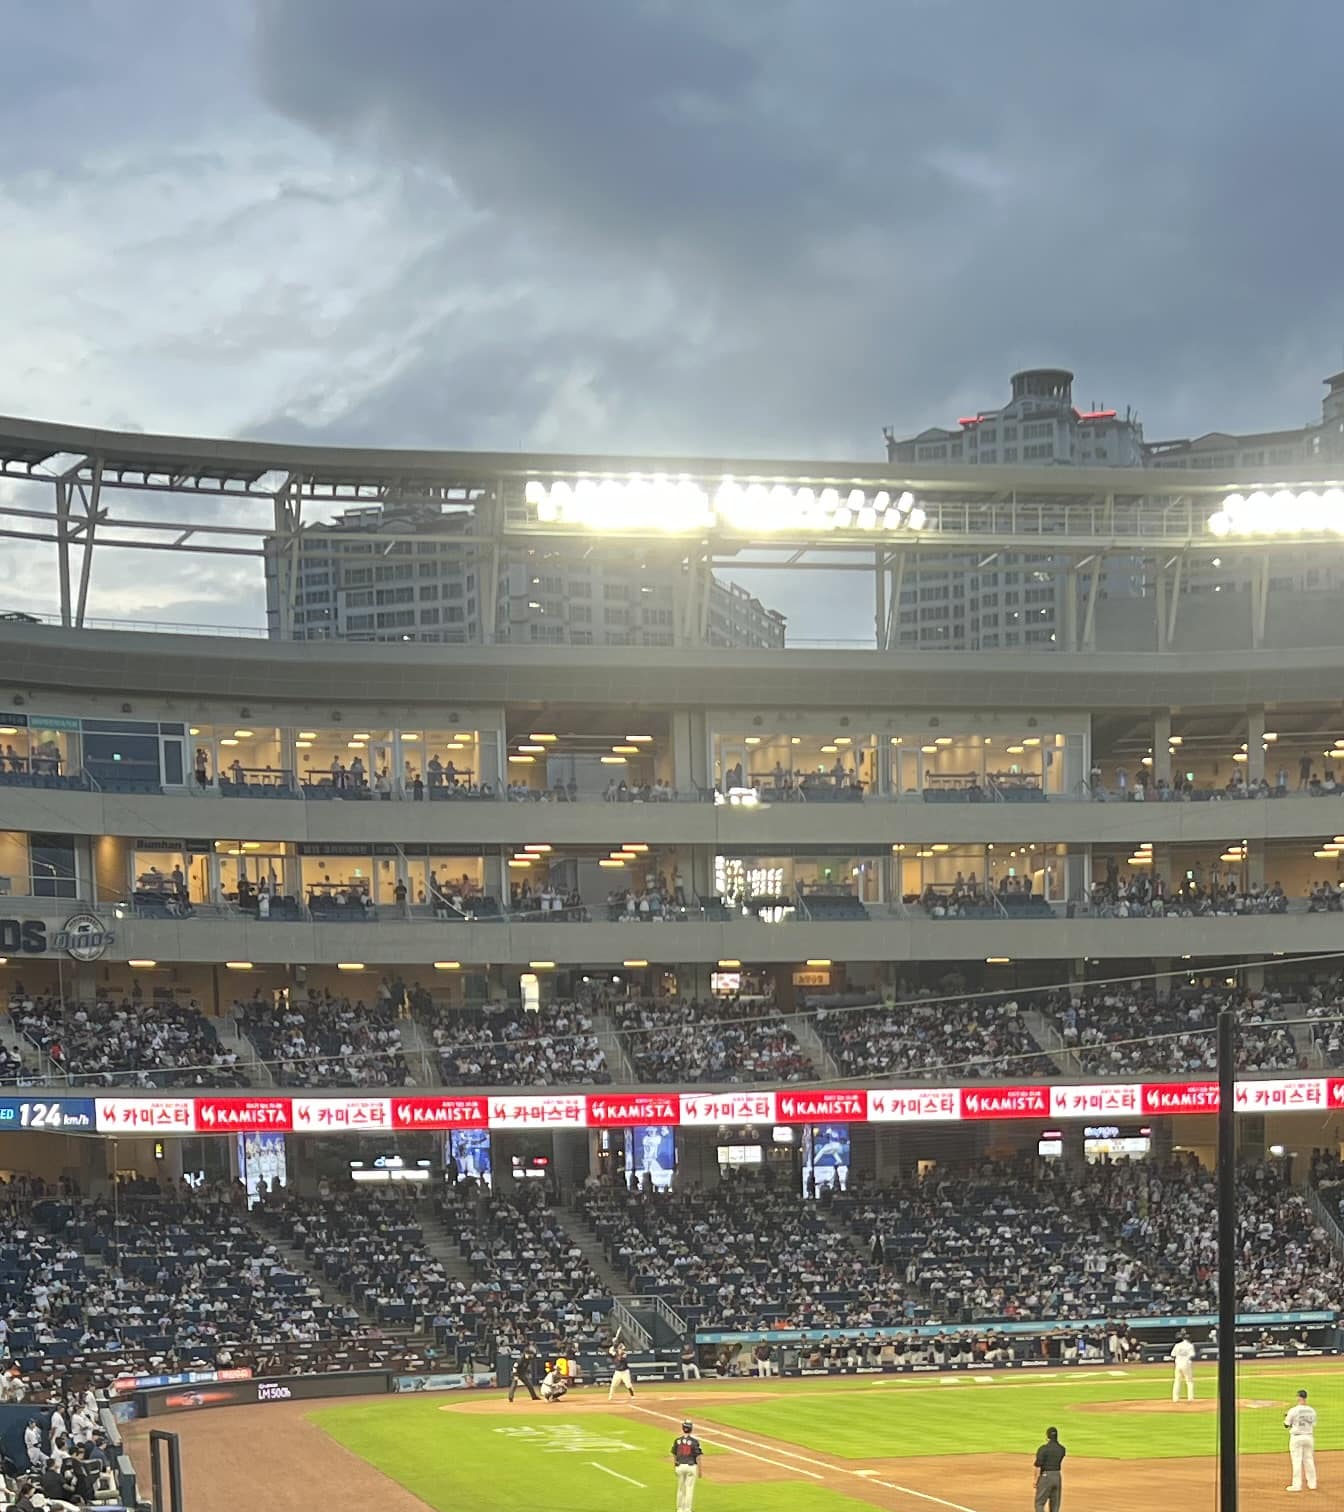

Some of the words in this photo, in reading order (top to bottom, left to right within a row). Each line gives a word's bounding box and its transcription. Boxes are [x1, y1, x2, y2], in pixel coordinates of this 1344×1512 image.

[980, 1094, 1045, 1111] KAMISTA
[1072, 1093, 1137, 1112] 카미스타
[1255, 1086, 1322, 1105] 카미스타
[19, 1103, 61, 1127] 124
[63, 1113, 89, 1126] km/h
[412, 1104, 482, 1122] KAMISTA
[608, 1103, 675, 1120] KAMISTA
[704, 1100, 770, 1119] 카미스타
[795, 1098, 862, 1115] KAMISTA
[891, 1097, 955, 1116] 카미스타
[122, 1107, 190, 1126] 카미스타
[217, 1108, 288, 1125] KAMISTA
[317, 1107, 386, 1126] 카미스타
